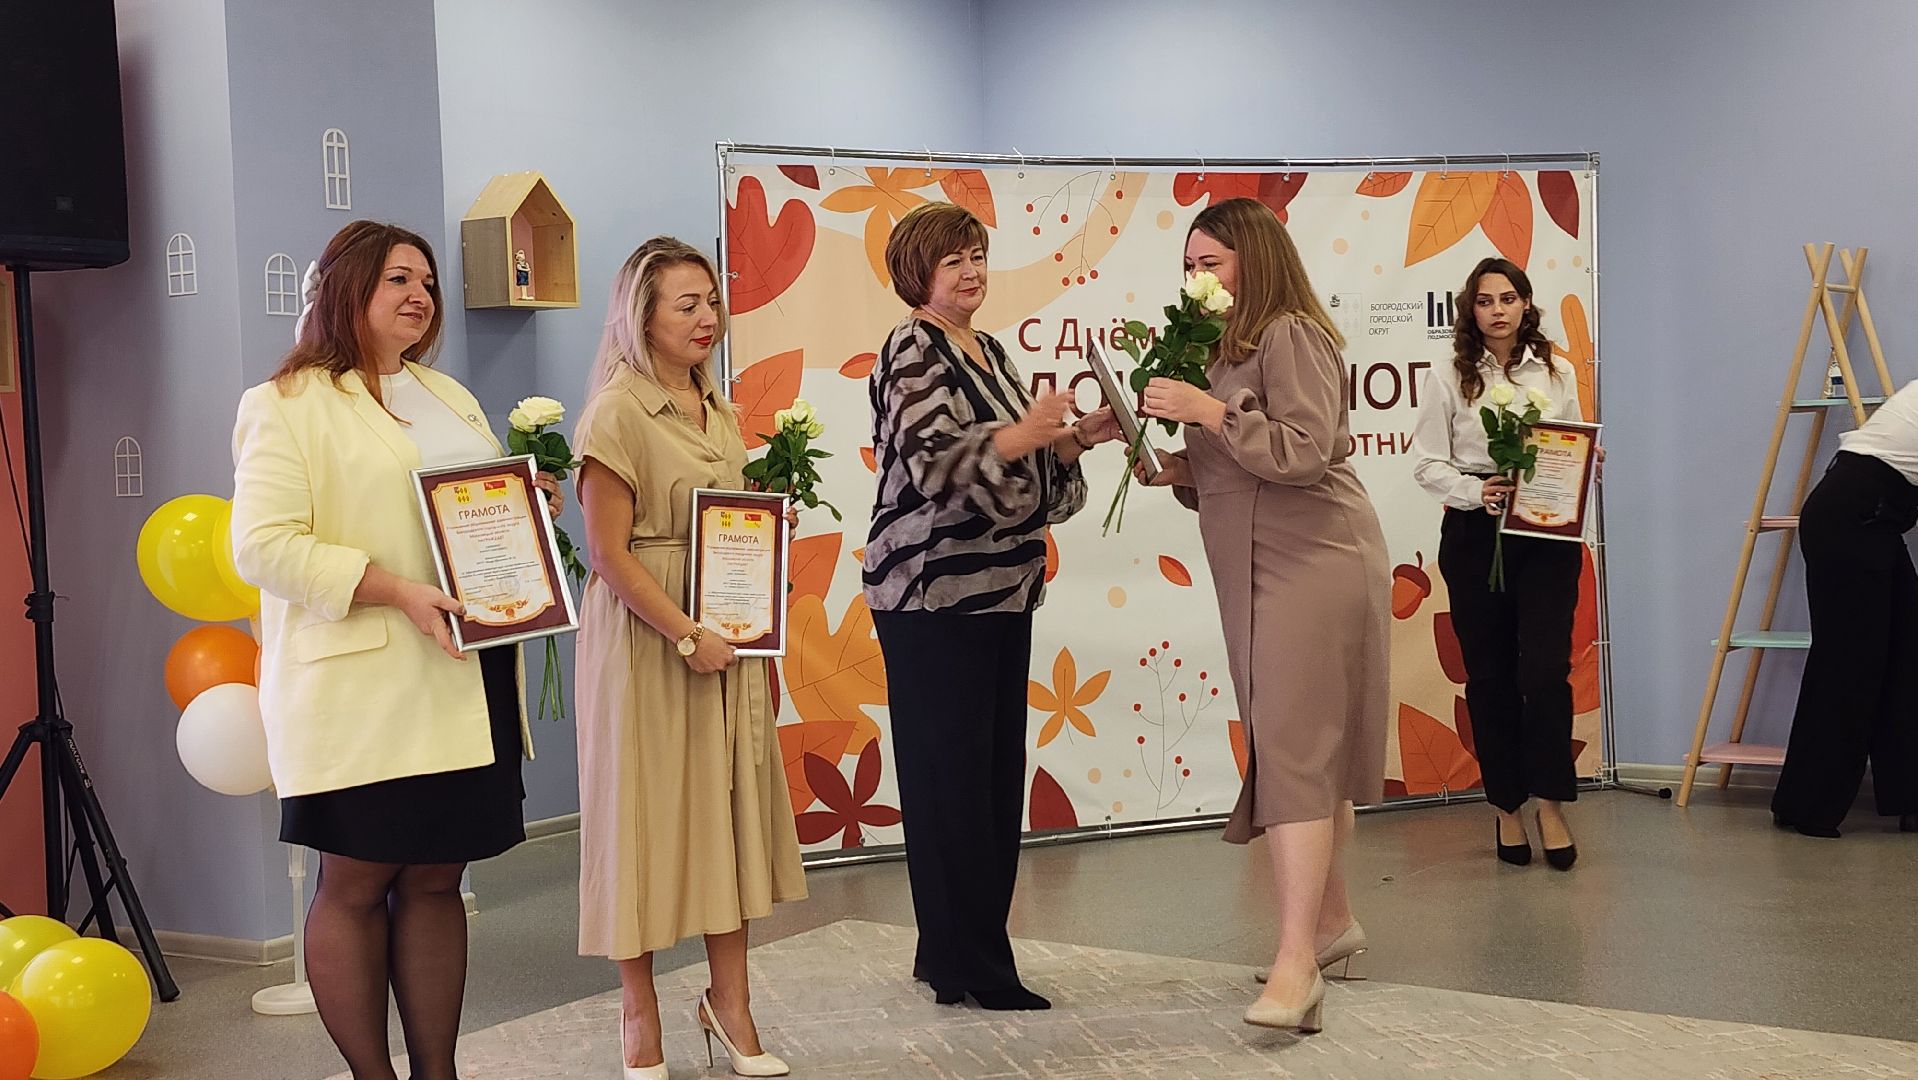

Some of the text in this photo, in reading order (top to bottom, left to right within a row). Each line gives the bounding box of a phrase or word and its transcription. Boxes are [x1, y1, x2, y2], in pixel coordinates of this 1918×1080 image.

[1370, 301, 1423, 312] БОГОРОДСКИЙ
[1369, 313, 1413, 324] ГОРОДСКОЙ
[1018, 318, 1042, 352] С
[1368, 327, 1390, 336] ОКРУГ
[458, 504, 511, 520] ГРАМОТА
[718, 534, 759, 544] ГРАМОТА
